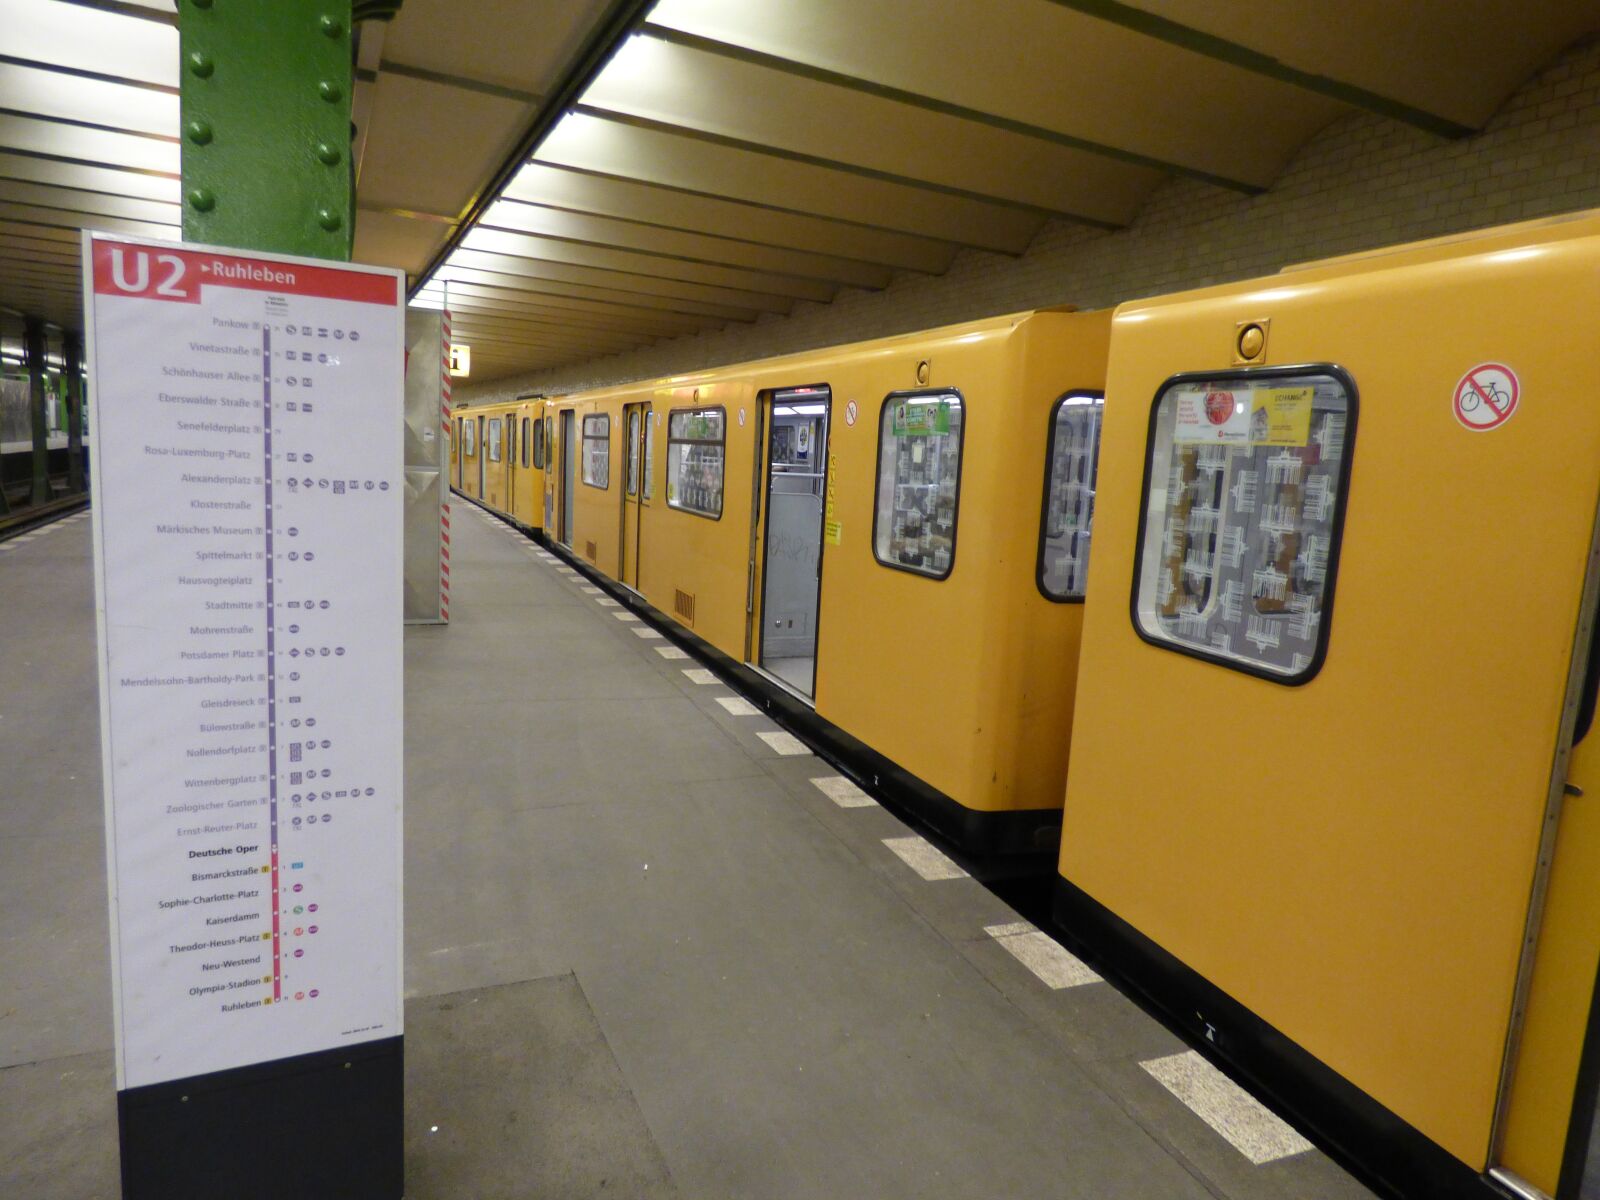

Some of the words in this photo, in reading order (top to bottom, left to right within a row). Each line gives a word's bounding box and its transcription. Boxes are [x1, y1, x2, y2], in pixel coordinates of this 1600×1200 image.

[110, 248, 188, 297] U2
[213, 263, 296, 285] Ruhleben
[212, 317, 249, 329] Pankow
[189, 342, 250, 356] Vinetastraße
[161, 366, 224, 380] Schönhauser
[226, 368, 251, 382] Allee
[158, 393, 218, 407] Eberswalder
[220, 396, 251, 408] Straße
[177, 421, 251, 435] Senefelderplatz
[144, 445, 251, 460] Rosa-Luxemburg-Platz
[182, 474, 252, 486] Alexanderplatz
[190, 500, 252, 510] Klosterstraße
[156, 524, 210, 535] Märkisches
[213, 526, 252, 535] Museum
[195, 550, 252, 562] Spittelmarkt
[178, 575, 253, 587] Hausvogteiplatz
[205, 599, 253, 610] Stadtmitte
[190, 625, 254, 635] Mohrenstraße
[181, 649, 231, 661] Potsdamer
[233, 648, 255, 658] Platz
[121, 673, 255, 688] Mendelssohn-Bartholdy-Park
[201, 697, 256, 709] Gleisdreieck
[200, 720, 256, 733] Bülowstraße
[186, 744, 257, 758] Nollendorfplatz
[184, 774, 257, 789] Wittenbergplatz
[166, 801, 225, 816] Zoologischer
[227, 798, 258, 808] Garten
[176, 821, 258, 837] Ernst-Reuter-Platz
[188, 847, 233, 859] Deutsche
[236, 843, 259, 856] Oper
[191, 866, 259, 882] Bismarckstraße
[158, 888, 260, 910] Sophie-Charlotte-Platz
[205, 911, 260, 926] Kaiserdamm
[169, 933, 260, 955] Theodor-Heuss-Platz
[202, 955, 261, 972] Neu-Westend
[189, 976, 261, 997] Olympia-Stadion
[221, 999, 262, 1012] Ruhleben
